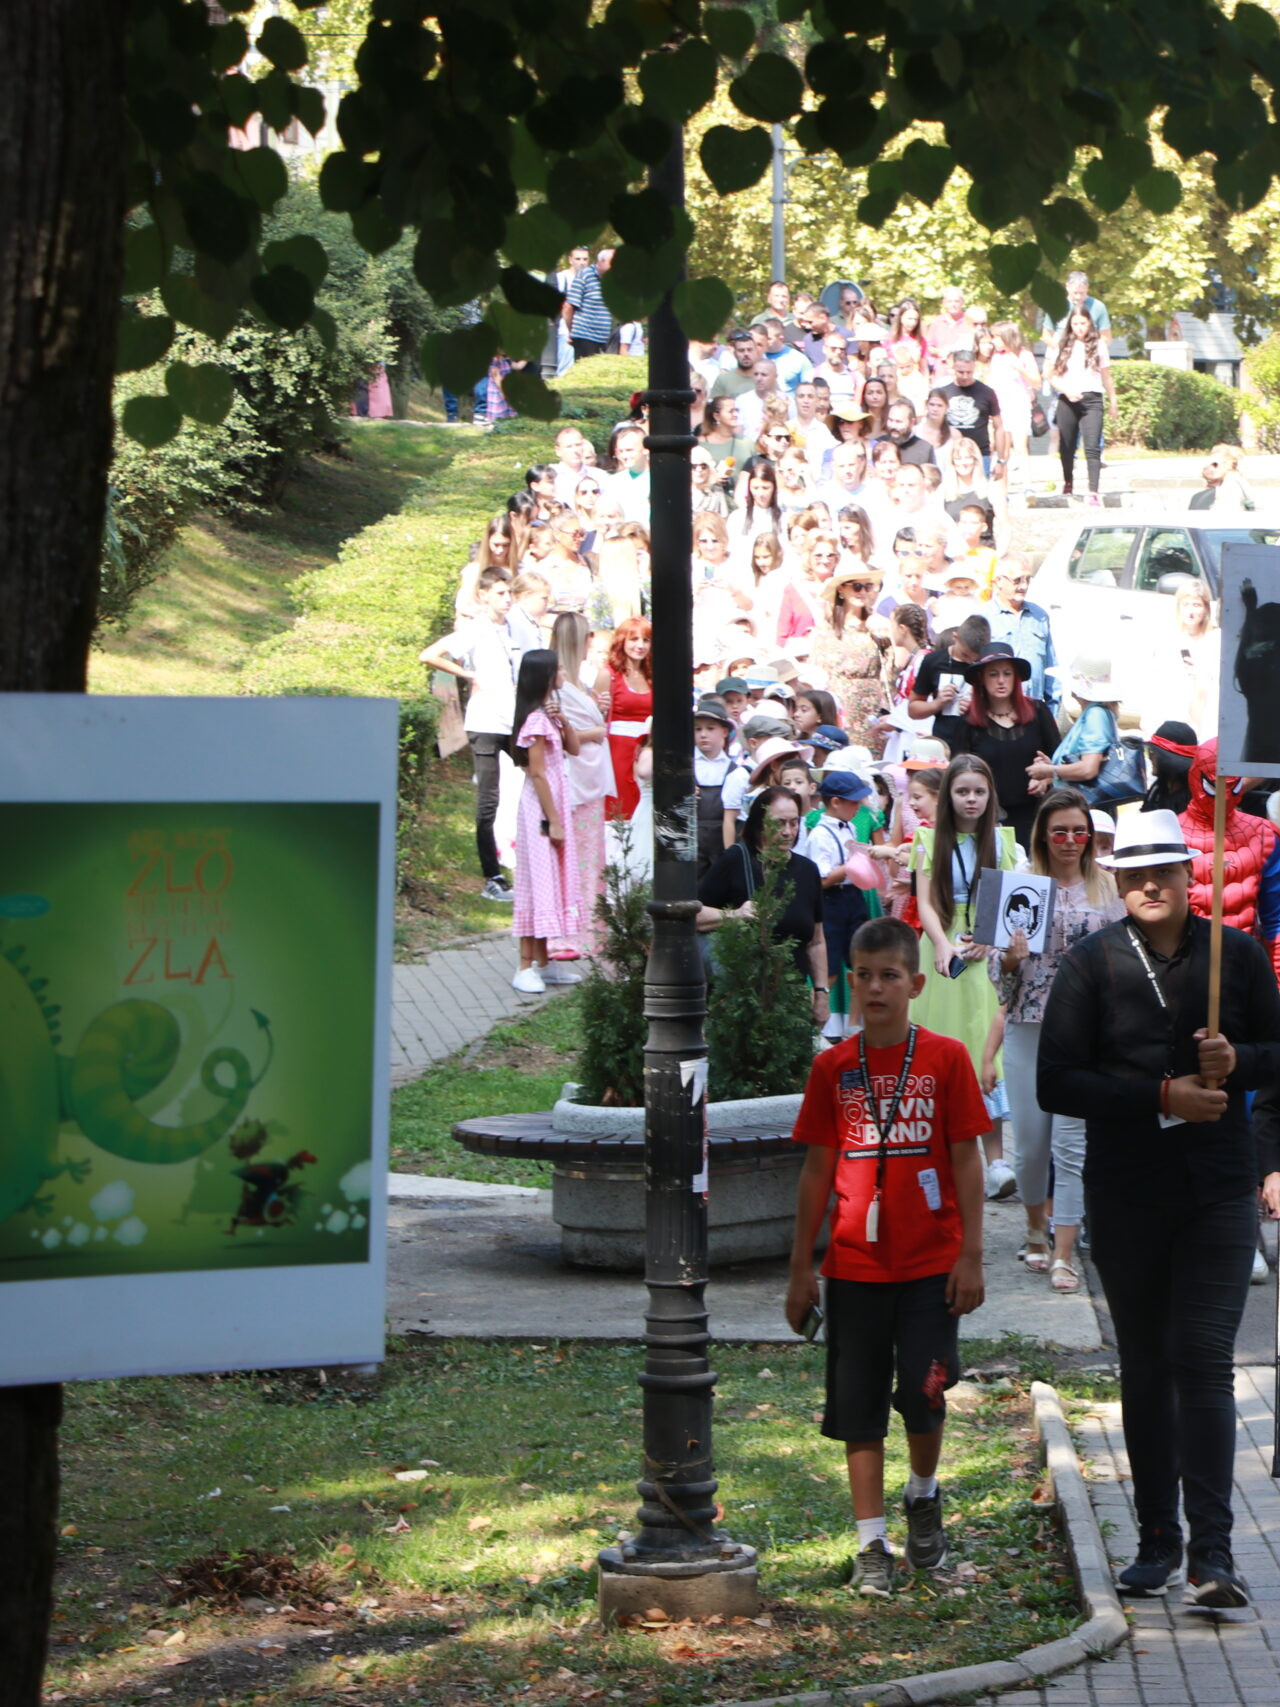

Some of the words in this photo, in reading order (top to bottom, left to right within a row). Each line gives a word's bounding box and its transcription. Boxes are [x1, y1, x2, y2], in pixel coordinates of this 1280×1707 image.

[126, 848, 234, 897] ZLO
[123, 936, 235, 985] ZLA
[865, 1120, 933, 1145] BRND
